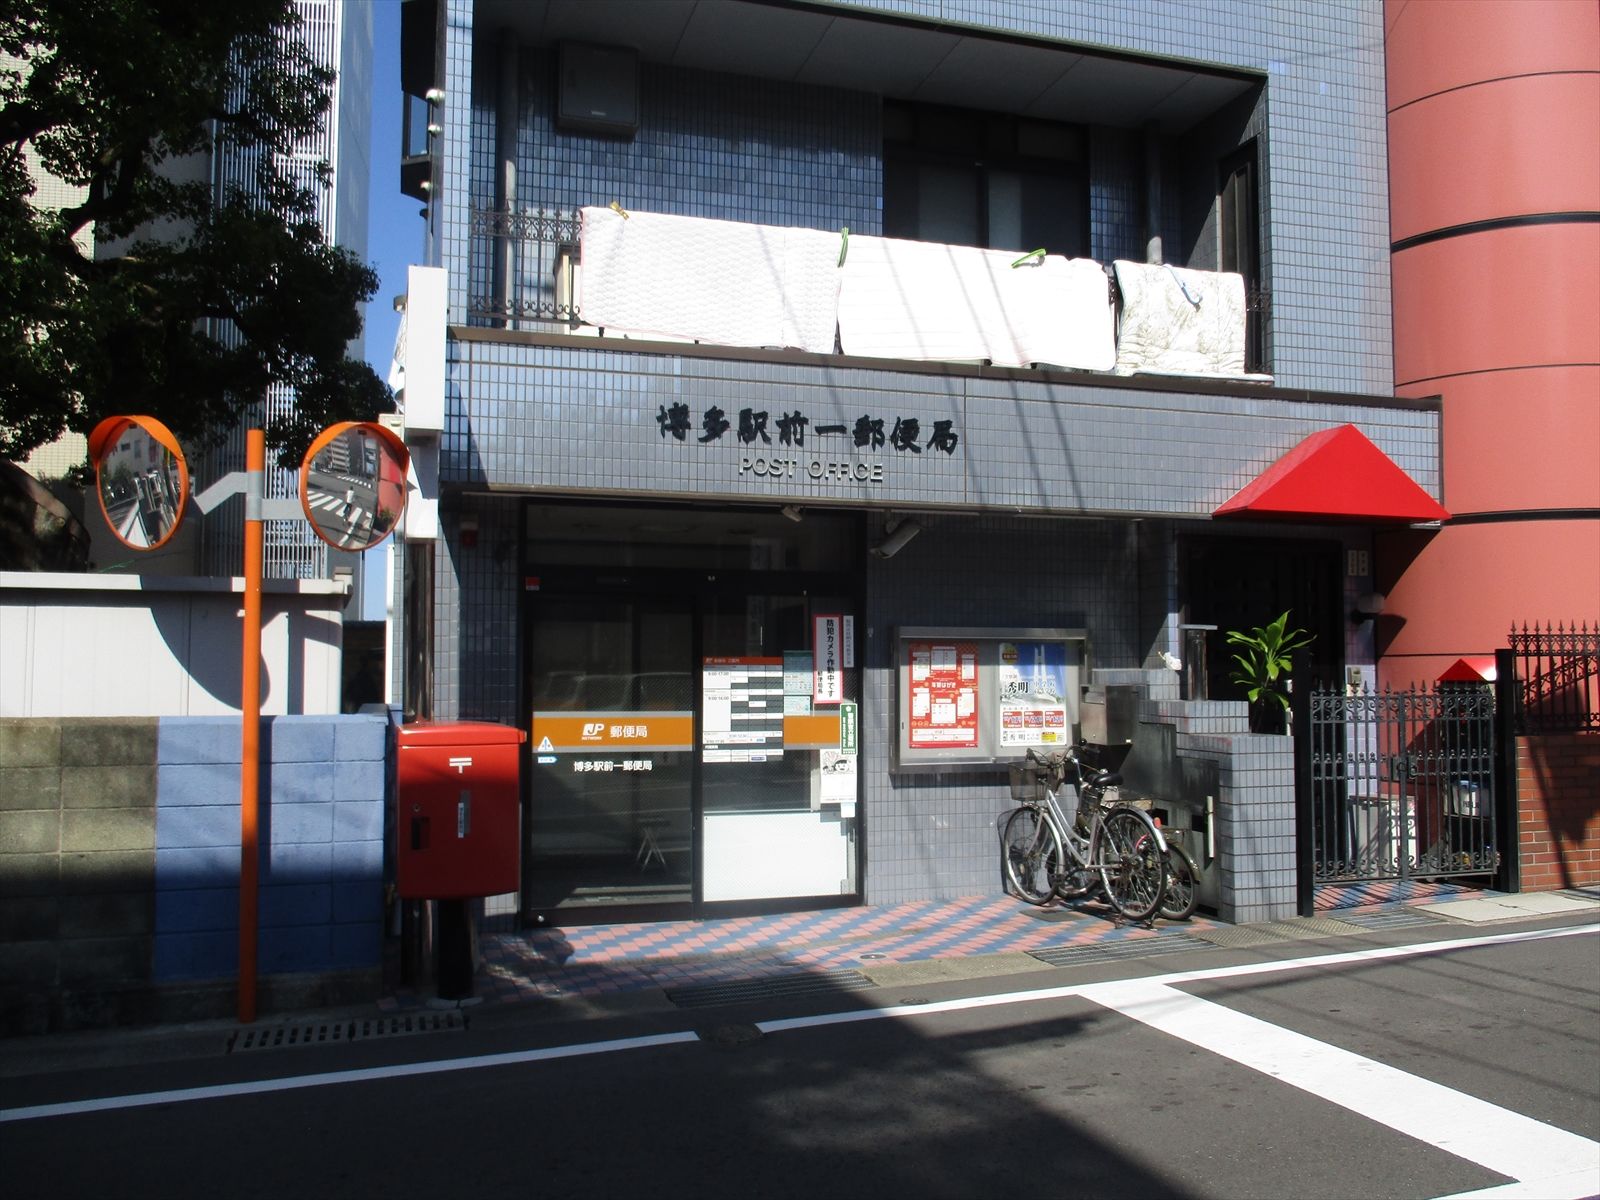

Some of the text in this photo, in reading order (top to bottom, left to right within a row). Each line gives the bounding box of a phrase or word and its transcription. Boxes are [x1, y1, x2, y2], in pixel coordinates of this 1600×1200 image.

[655, 402, 960, 455] 博多駅前一郵便局
[738, 456, 885, 484] POST OFFICE
[826, 618, 836, 697] 防犯カメラ作動中です
[610, 725, 648, 738] 郵便局
[573, 760, 653, 772] 博多駅前一郵便局
